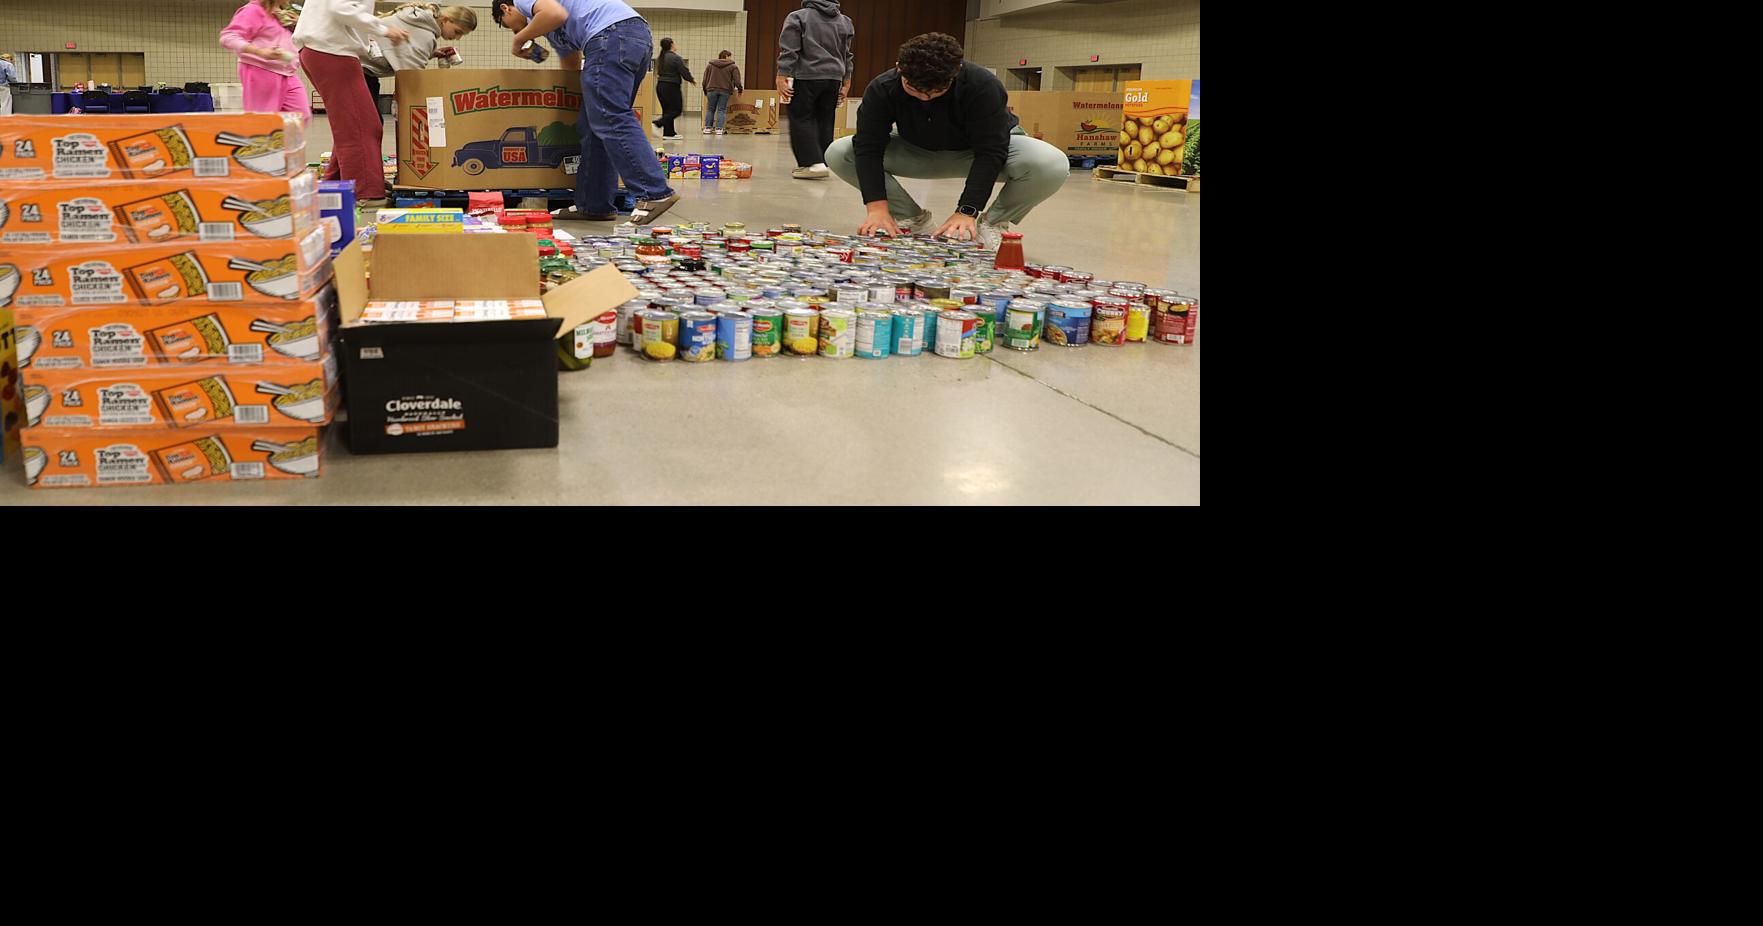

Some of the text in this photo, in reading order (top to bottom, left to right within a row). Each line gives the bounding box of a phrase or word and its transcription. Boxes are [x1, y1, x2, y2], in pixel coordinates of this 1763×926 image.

[1125, 92, 1148, 102] Gold
[16, 140, 33, 151] 24
[54, 140, 79, 149] Top
[503, 152, 526, 161] USA
[22, 204, 39, 215] 24
[60, 204, 84, 213] Top
[405, 214, 454, 222] FAMILY SIZE
[33, 269, 50, 279] 24
[70, 268, 94, 276] Top
[53, 330, 70, 341] 24
[92, 330, 116, 338] Top
[63, 390, 81, 400] 24
[100, 390, 124, 398] Top
[385, 398, 462, 412] Cloverdale
[60, 450, 77, 460] 24
